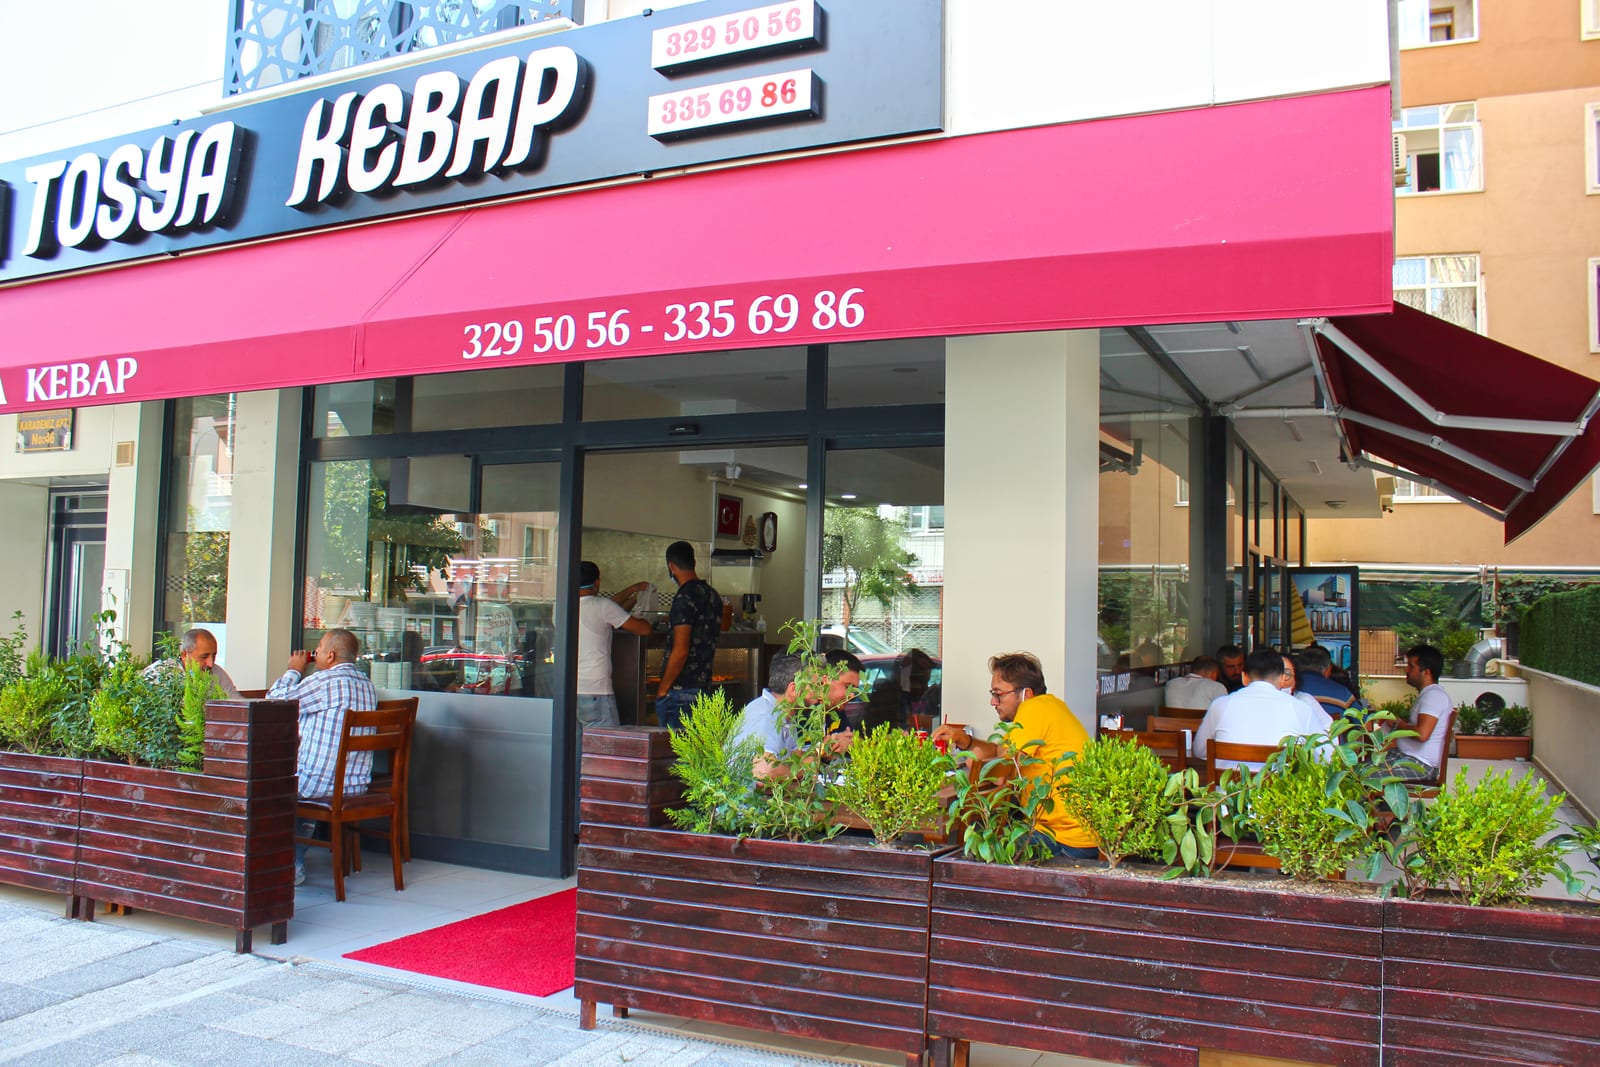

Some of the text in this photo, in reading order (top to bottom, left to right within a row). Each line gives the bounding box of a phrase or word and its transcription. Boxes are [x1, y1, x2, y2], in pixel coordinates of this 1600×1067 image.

[666, 7, 802, 57] 329 50 56
[661, 78, 797, 124] 335 69 86
[23, 46, 579, 257] TOSYA KEBAP
[462, 287, 866, 360] 329 50 56 - 335 69 86
[26, 357, 138, 402] KEBAP
